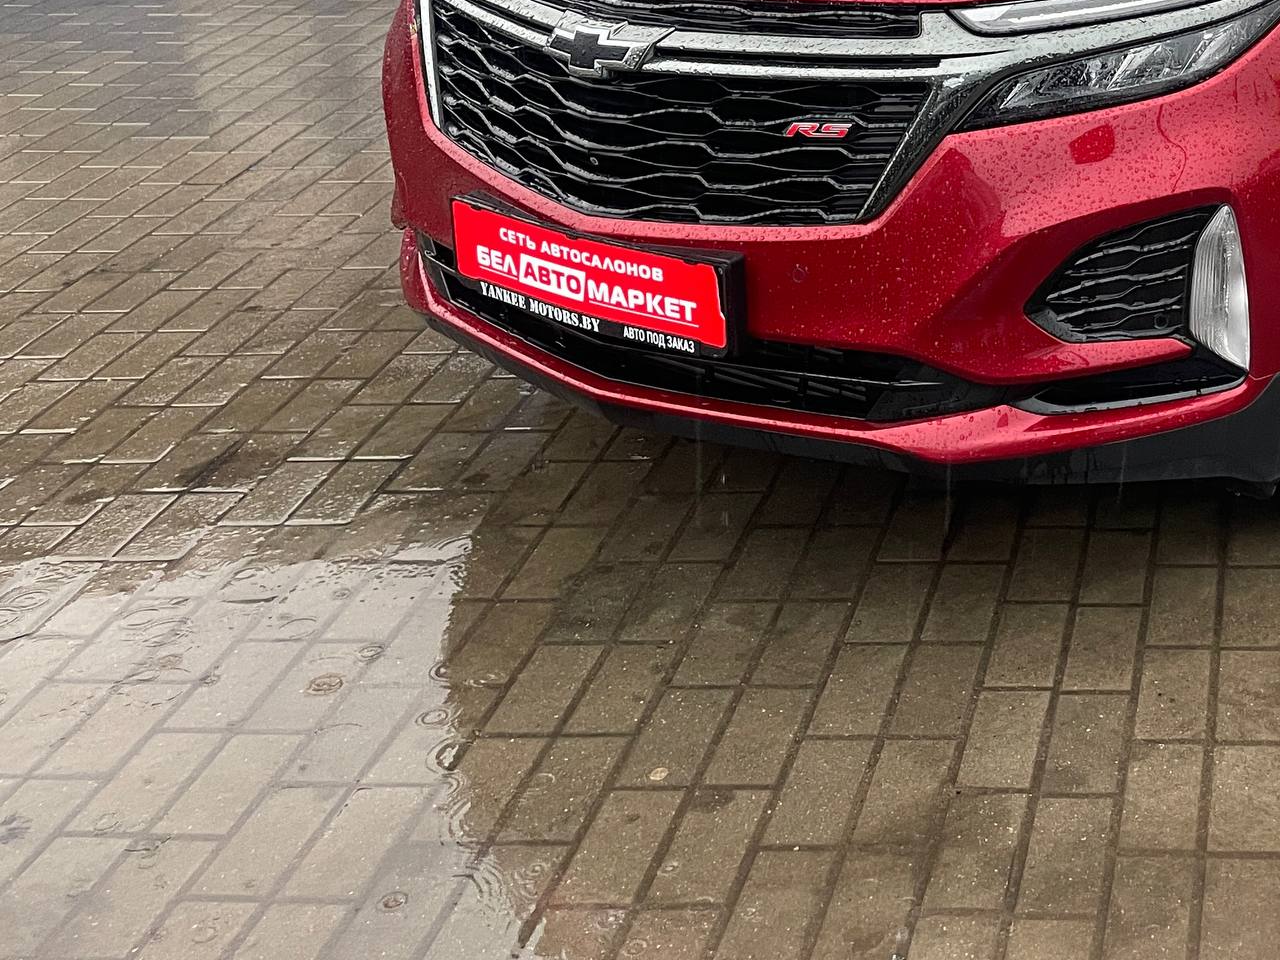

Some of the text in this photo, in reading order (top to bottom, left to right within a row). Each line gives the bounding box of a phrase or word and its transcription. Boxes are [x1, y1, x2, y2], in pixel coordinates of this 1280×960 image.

[785, 122, 852, 138] RS
[499, 227, 664, 282] СЕТЬ АВТОСАЛОНОВ
[476, 244, 697, 322] БЕЛ АВТО МАРКЕТ
[480, 281, 600, 333] YANKEE MOTORS.BY
[623, 325, 695, 353] АВТО ПОД ЗАКАЗ
